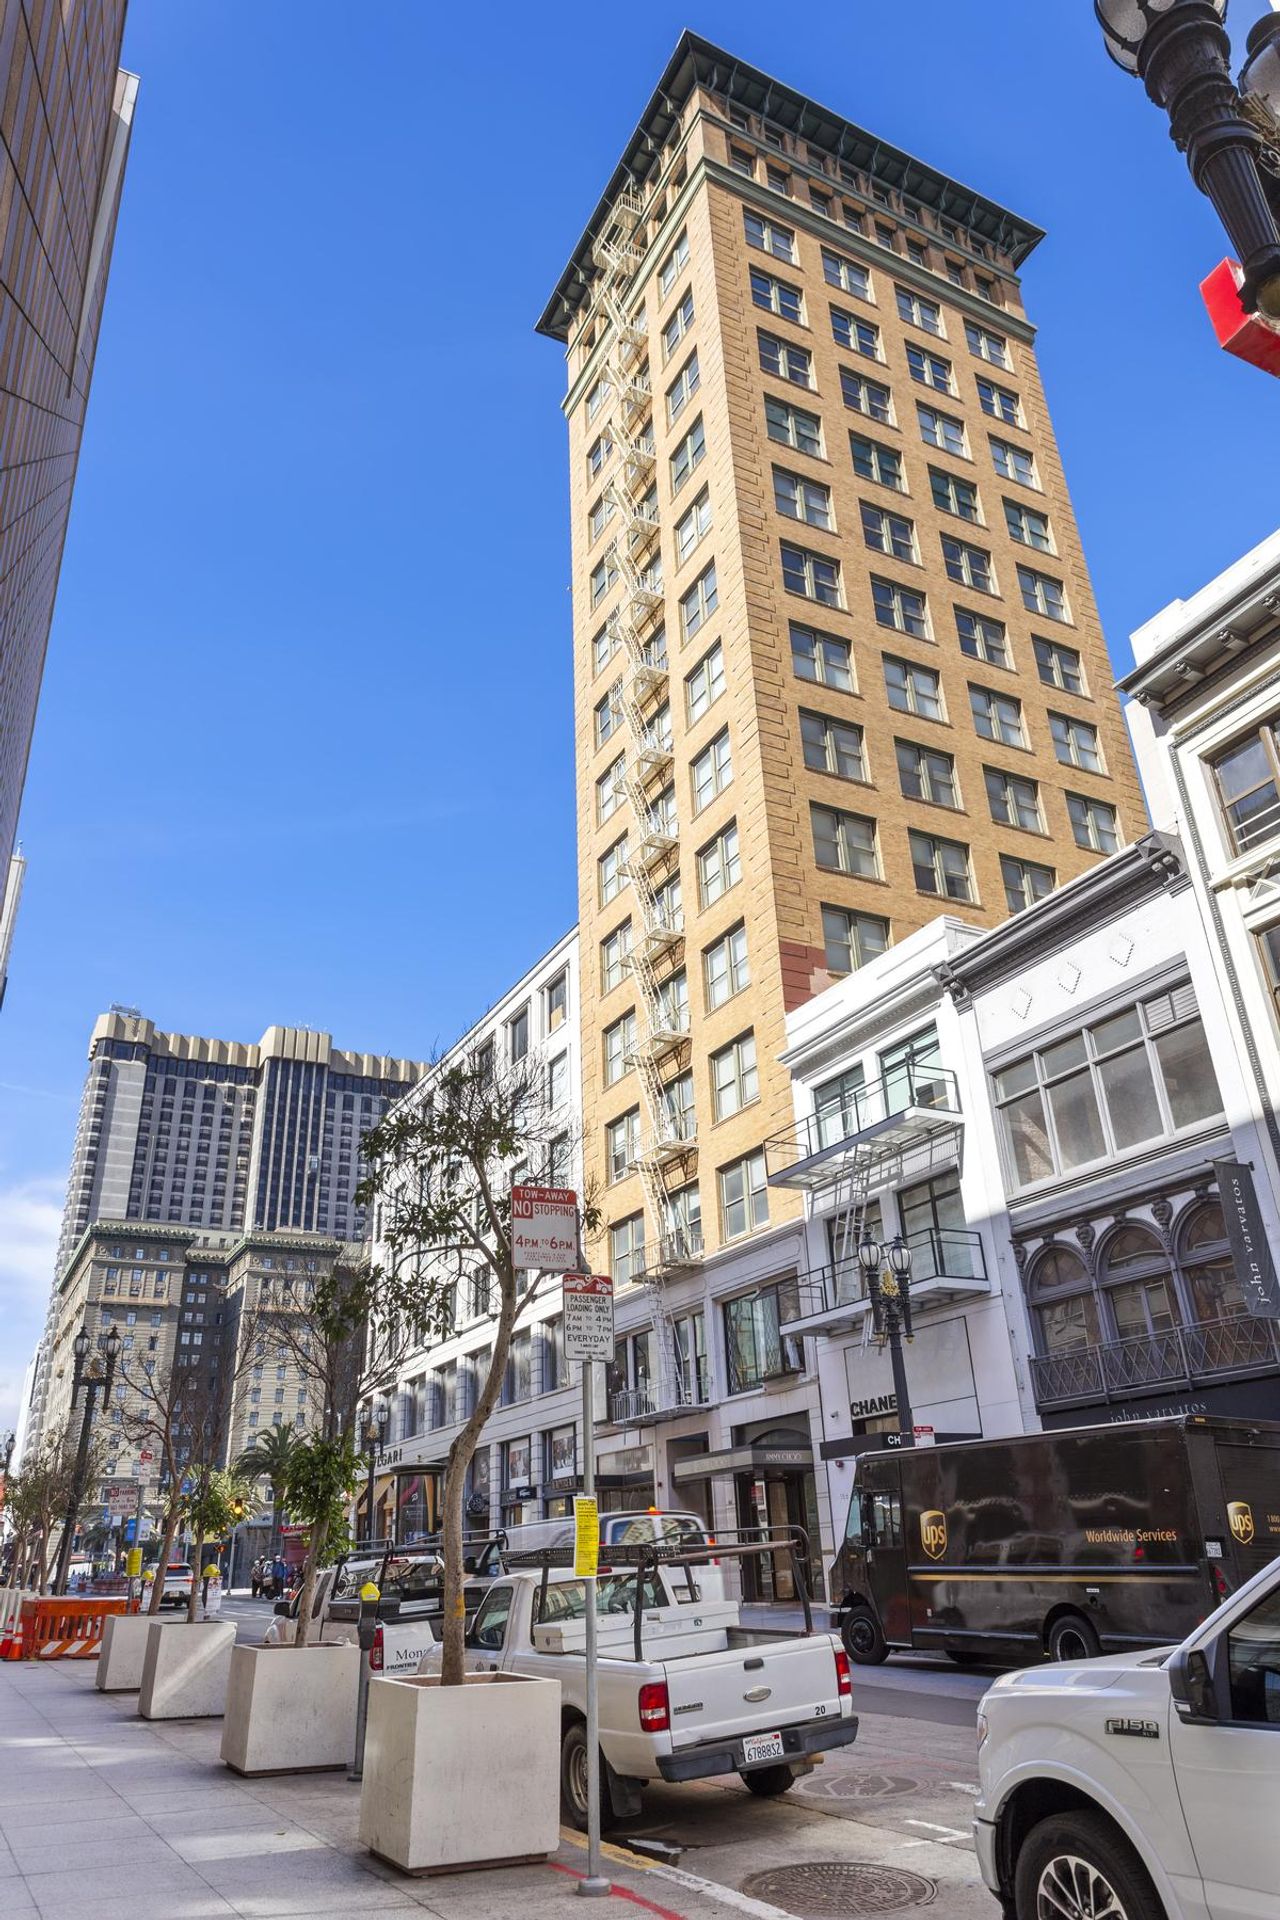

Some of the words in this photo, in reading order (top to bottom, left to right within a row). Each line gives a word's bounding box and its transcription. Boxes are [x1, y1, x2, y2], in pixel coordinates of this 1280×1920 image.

[519, 1189, 570, 1202] TOW-AWAY
[513, 1200, 532, 1216] NO
[534, 1203, 575, 1218] STOPPING
[1231, 1178, 1254, 1253] varvatos
[1250, 1262, 1272, 1304] john
[570, 1294, 607, 1305] PASSENGER
[566, 1303, 593, 1313] LOADING
[594, 1304, 610, 1314] ONLY
[567, 1334, 611, 1344] EVERYDAY
[850, 1393, 898, 1417] CHANE
[887, 1435, 901, 1445] CH
[1231, 1514, 1251, 1537] ups
[922, 1525, 945, 1552] ups
[1085, 1528, 1135, 1544] Worldwide
[1136, 1527, 1178, 1542] Services
[395, 1648, 427, 1661] Mon
[814, 1705, 826, 1716] 20
